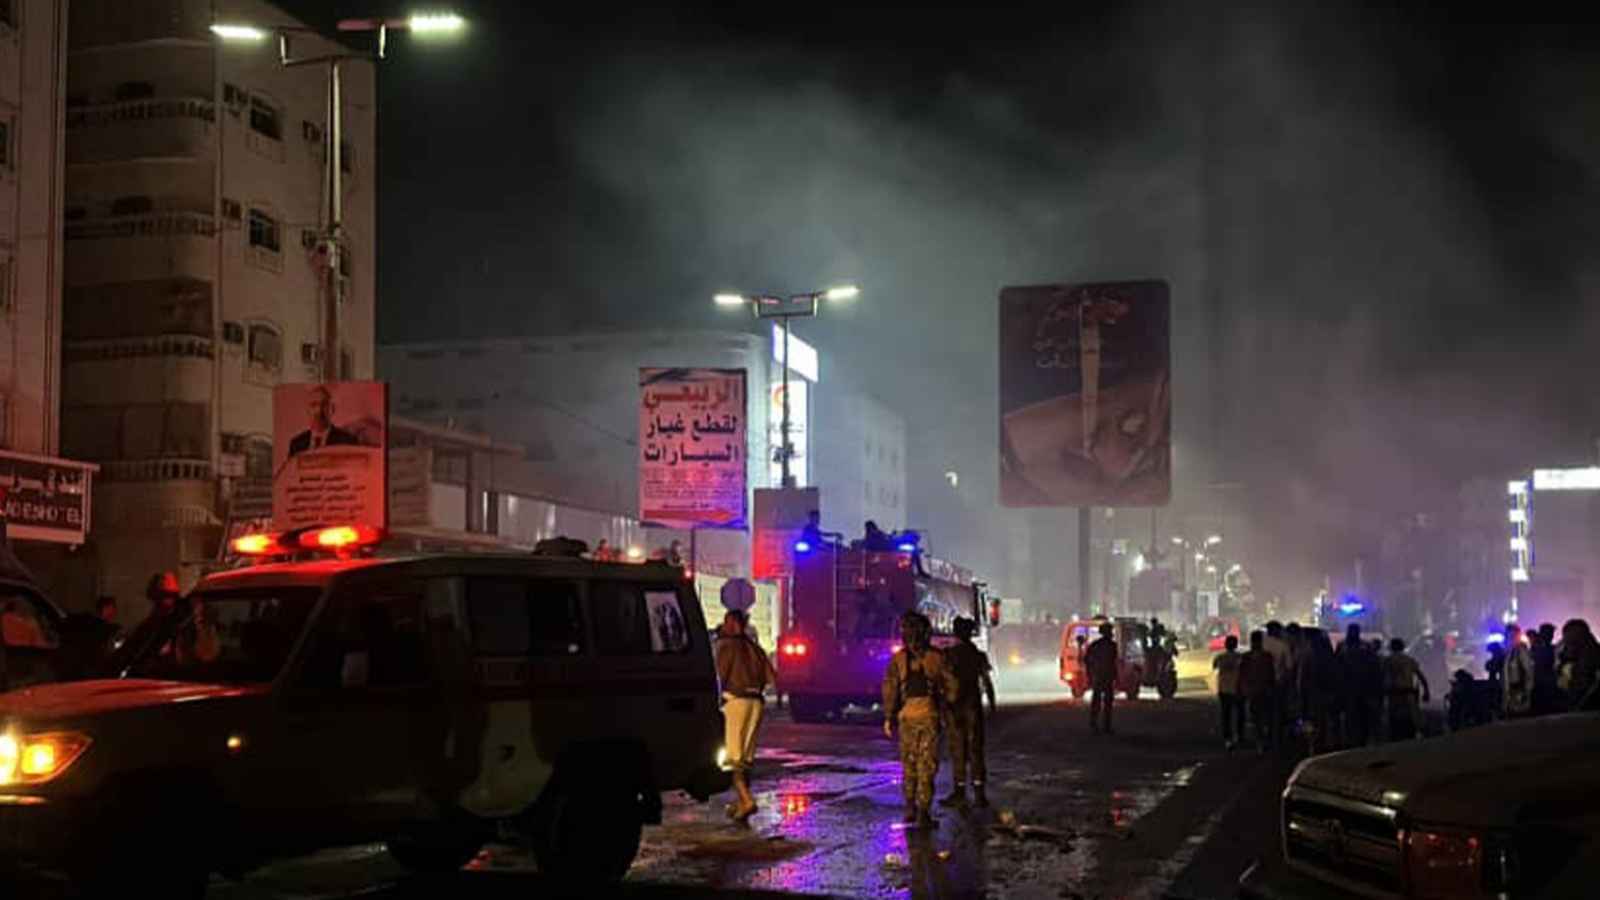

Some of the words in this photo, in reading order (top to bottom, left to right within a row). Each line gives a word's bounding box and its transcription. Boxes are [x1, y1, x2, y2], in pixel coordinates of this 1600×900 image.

[646, 412, 685, 439] غيار
[692, 413, 737, 441] لقطع
[644, 442, 739, 467] السيارات
